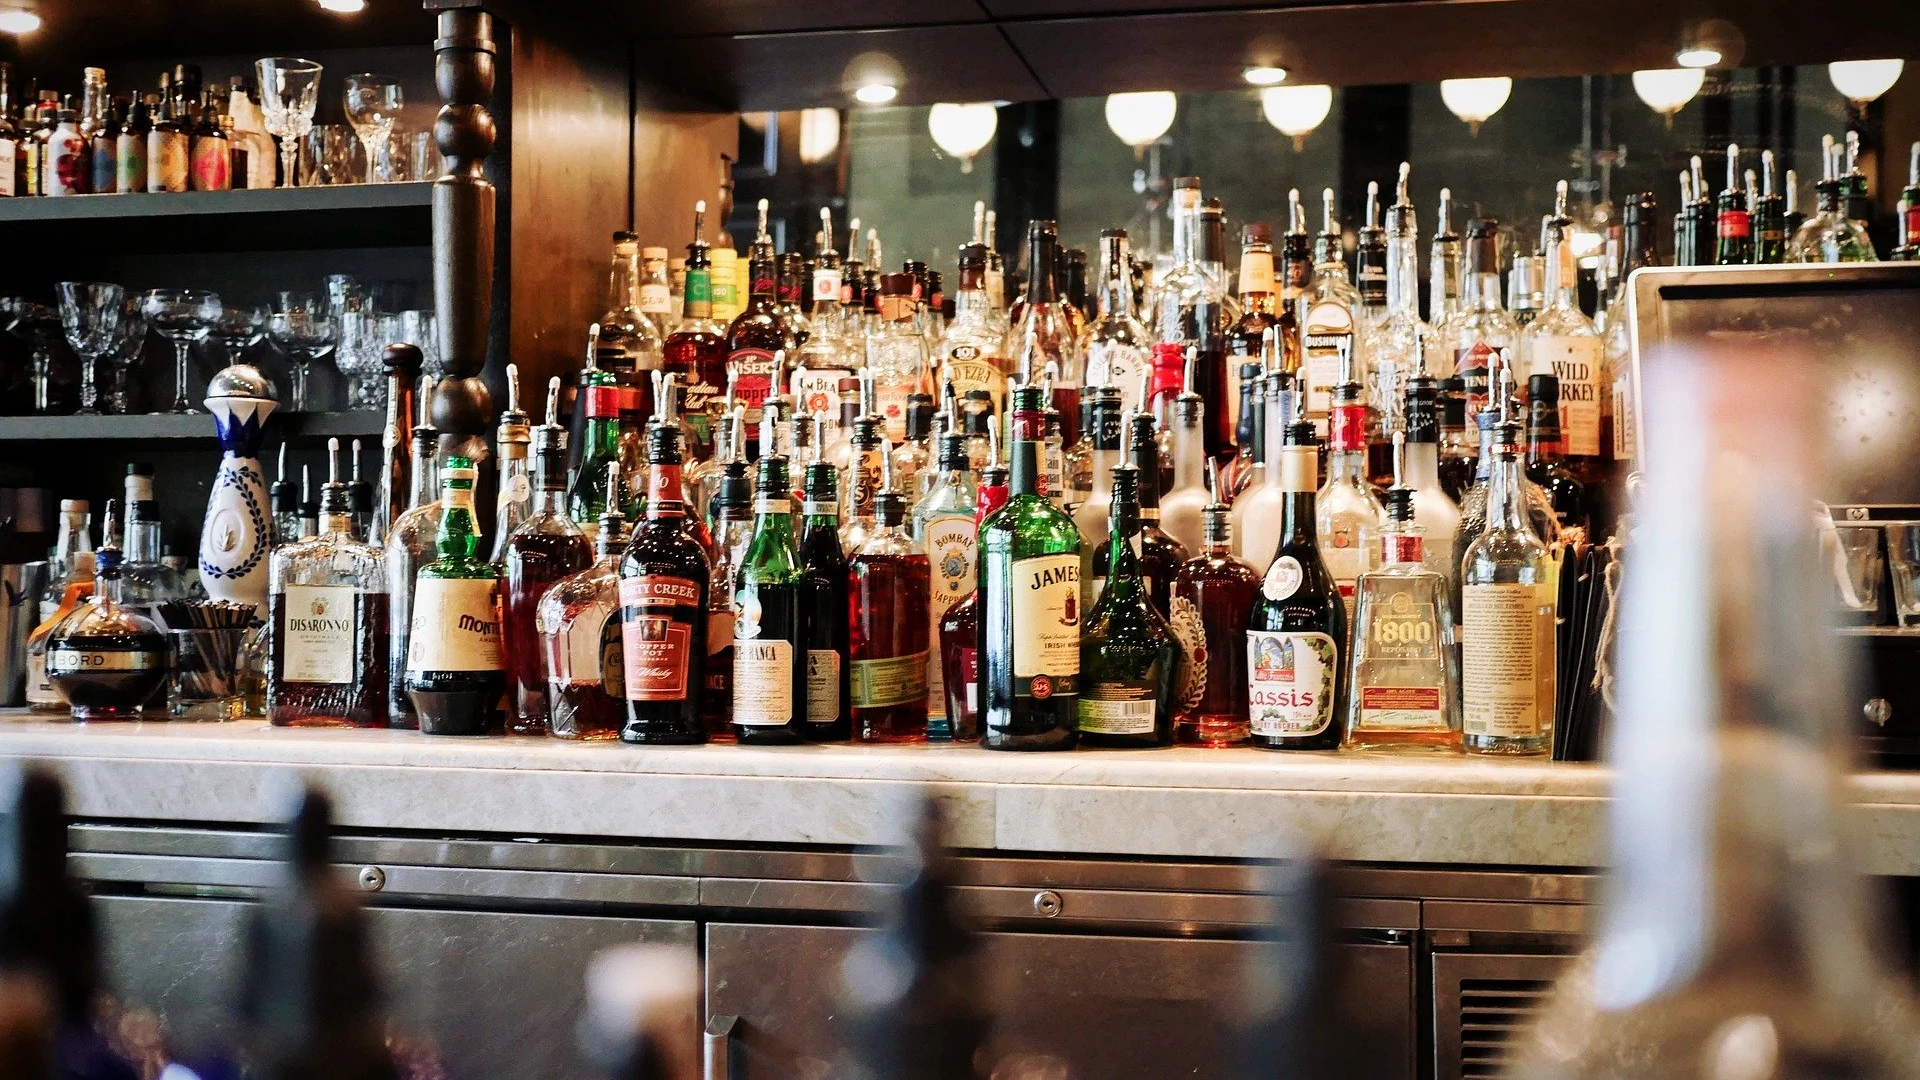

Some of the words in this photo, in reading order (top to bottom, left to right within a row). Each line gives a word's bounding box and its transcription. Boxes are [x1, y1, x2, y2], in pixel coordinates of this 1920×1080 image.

[1552, 361, 1589, 380] WILD
[1560, 383, 1596, 401] RKEY
[935, 533, 974, 550] BOMBAY
[653, 583, 695, 598] CREEK
[290, 619, 350, 633] DISARONNO
[1372, 619, 1432, 644] 1800
